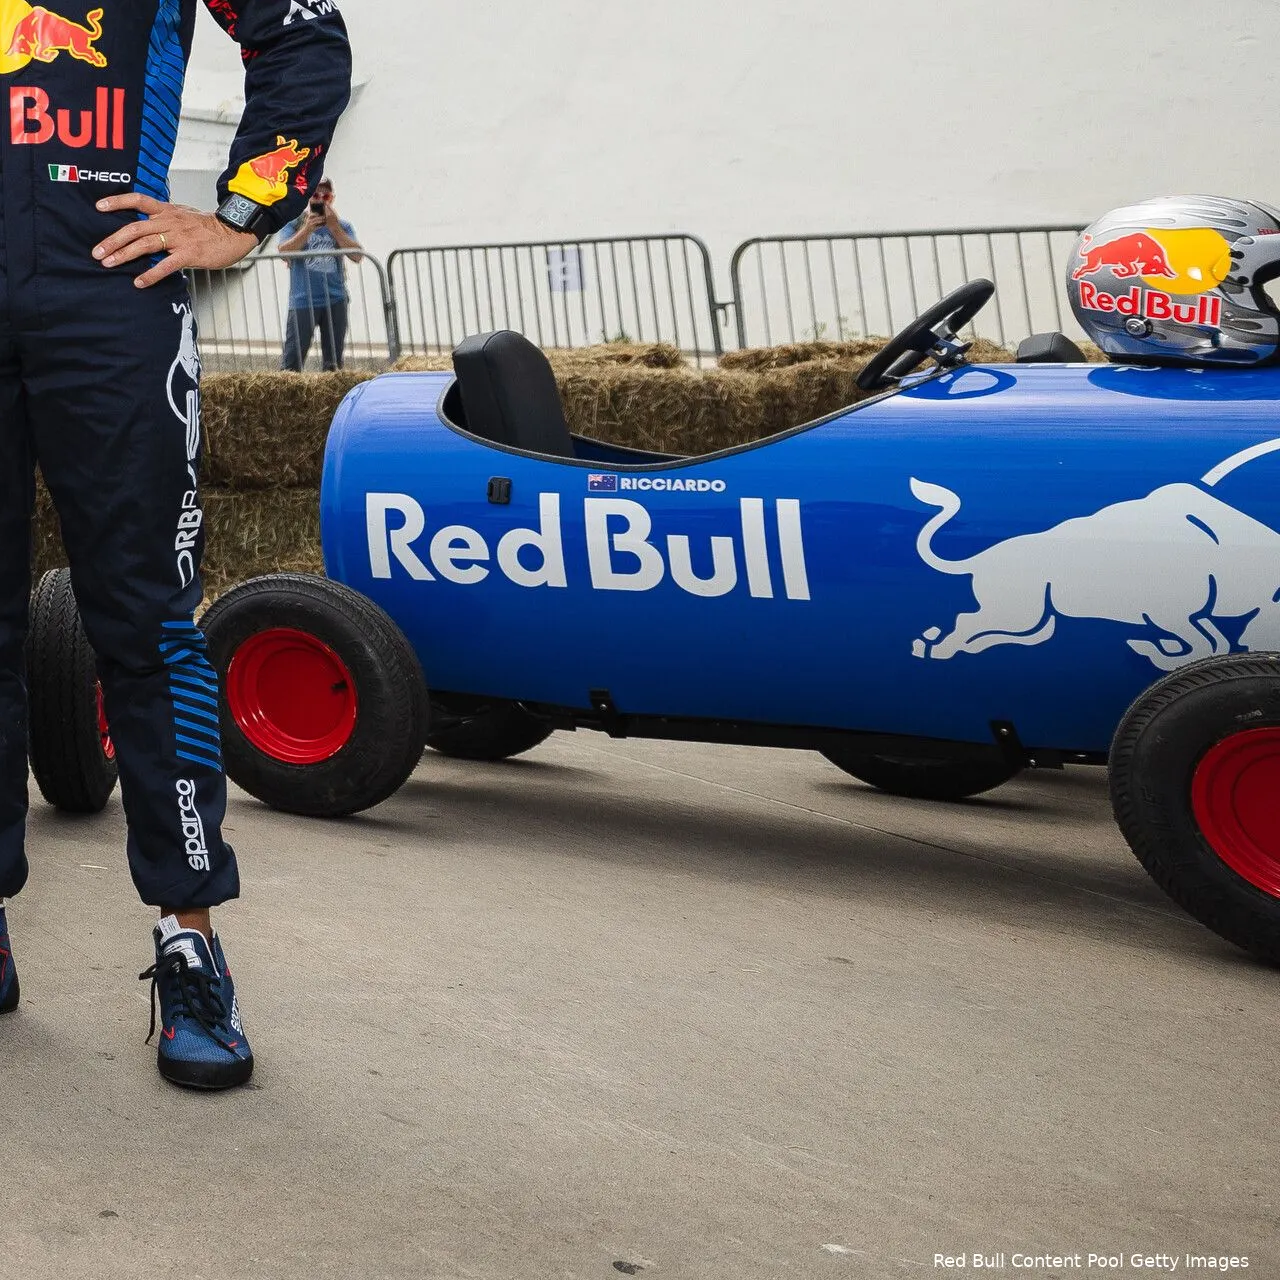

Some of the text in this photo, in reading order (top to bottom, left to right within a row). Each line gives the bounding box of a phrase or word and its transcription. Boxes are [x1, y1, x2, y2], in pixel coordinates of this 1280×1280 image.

[9, 86, 125, 150] Bull
[78, 170, 131, 184] CHECO
[1079, 281, 1222, 327] Red Bull
[620, 477, 727, 493] RICCIARDO
[365, 492, 811, 601] Red Bull
[176, 778, 209, 871] sparco
